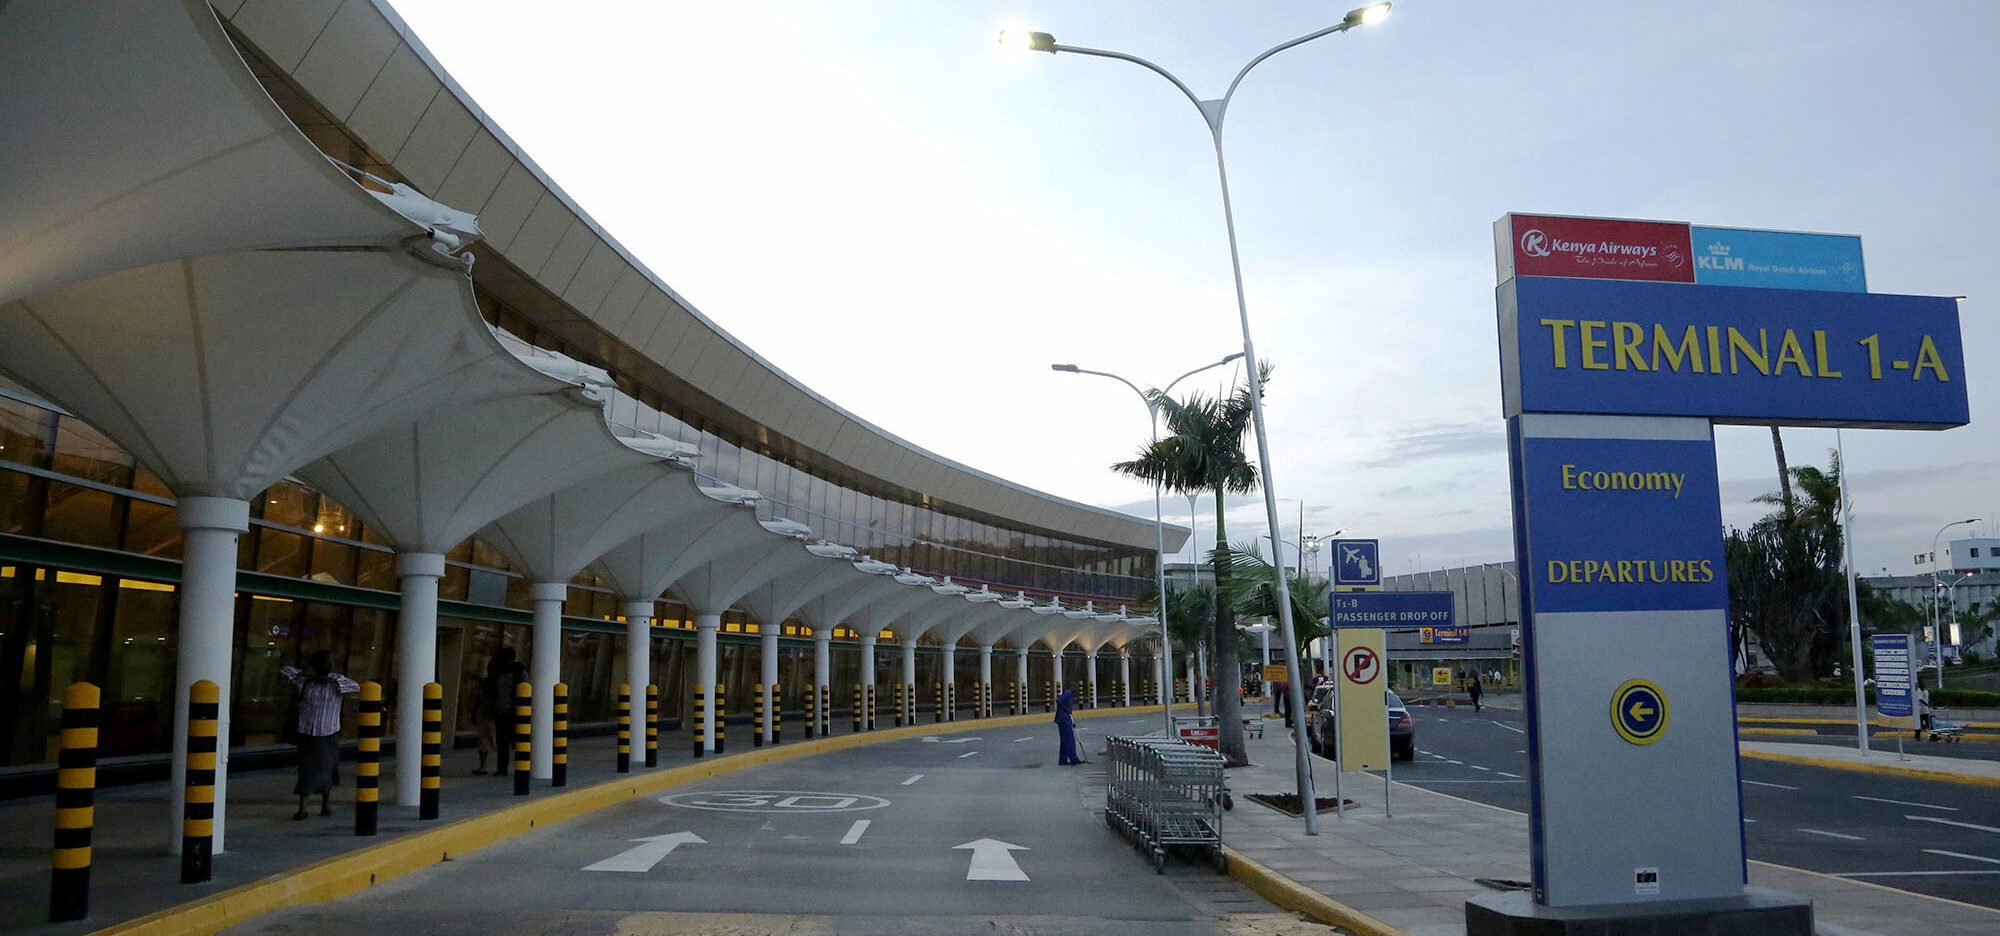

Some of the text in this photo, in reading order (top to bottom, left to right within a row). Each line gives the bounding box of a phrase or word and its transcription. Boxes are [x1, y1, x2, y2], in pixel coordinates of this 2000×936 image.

[1552, 239, 1596, 255] Kenya
[1599, 241, 1657, 258] Airways
[1698, 255, 1744, 271] KLM
[1748, 263, 1770, 273] Royal
[1540, 318, 1951, 382] TERMINAL 1-A
[1562, 464, 1686, 499] Economy
[1547, 559, 1714, 583] DEPARTURES
[1336, 611, 1449, 622] PASSENGER DROP OFF
[691, 793, 858, 809] 30
